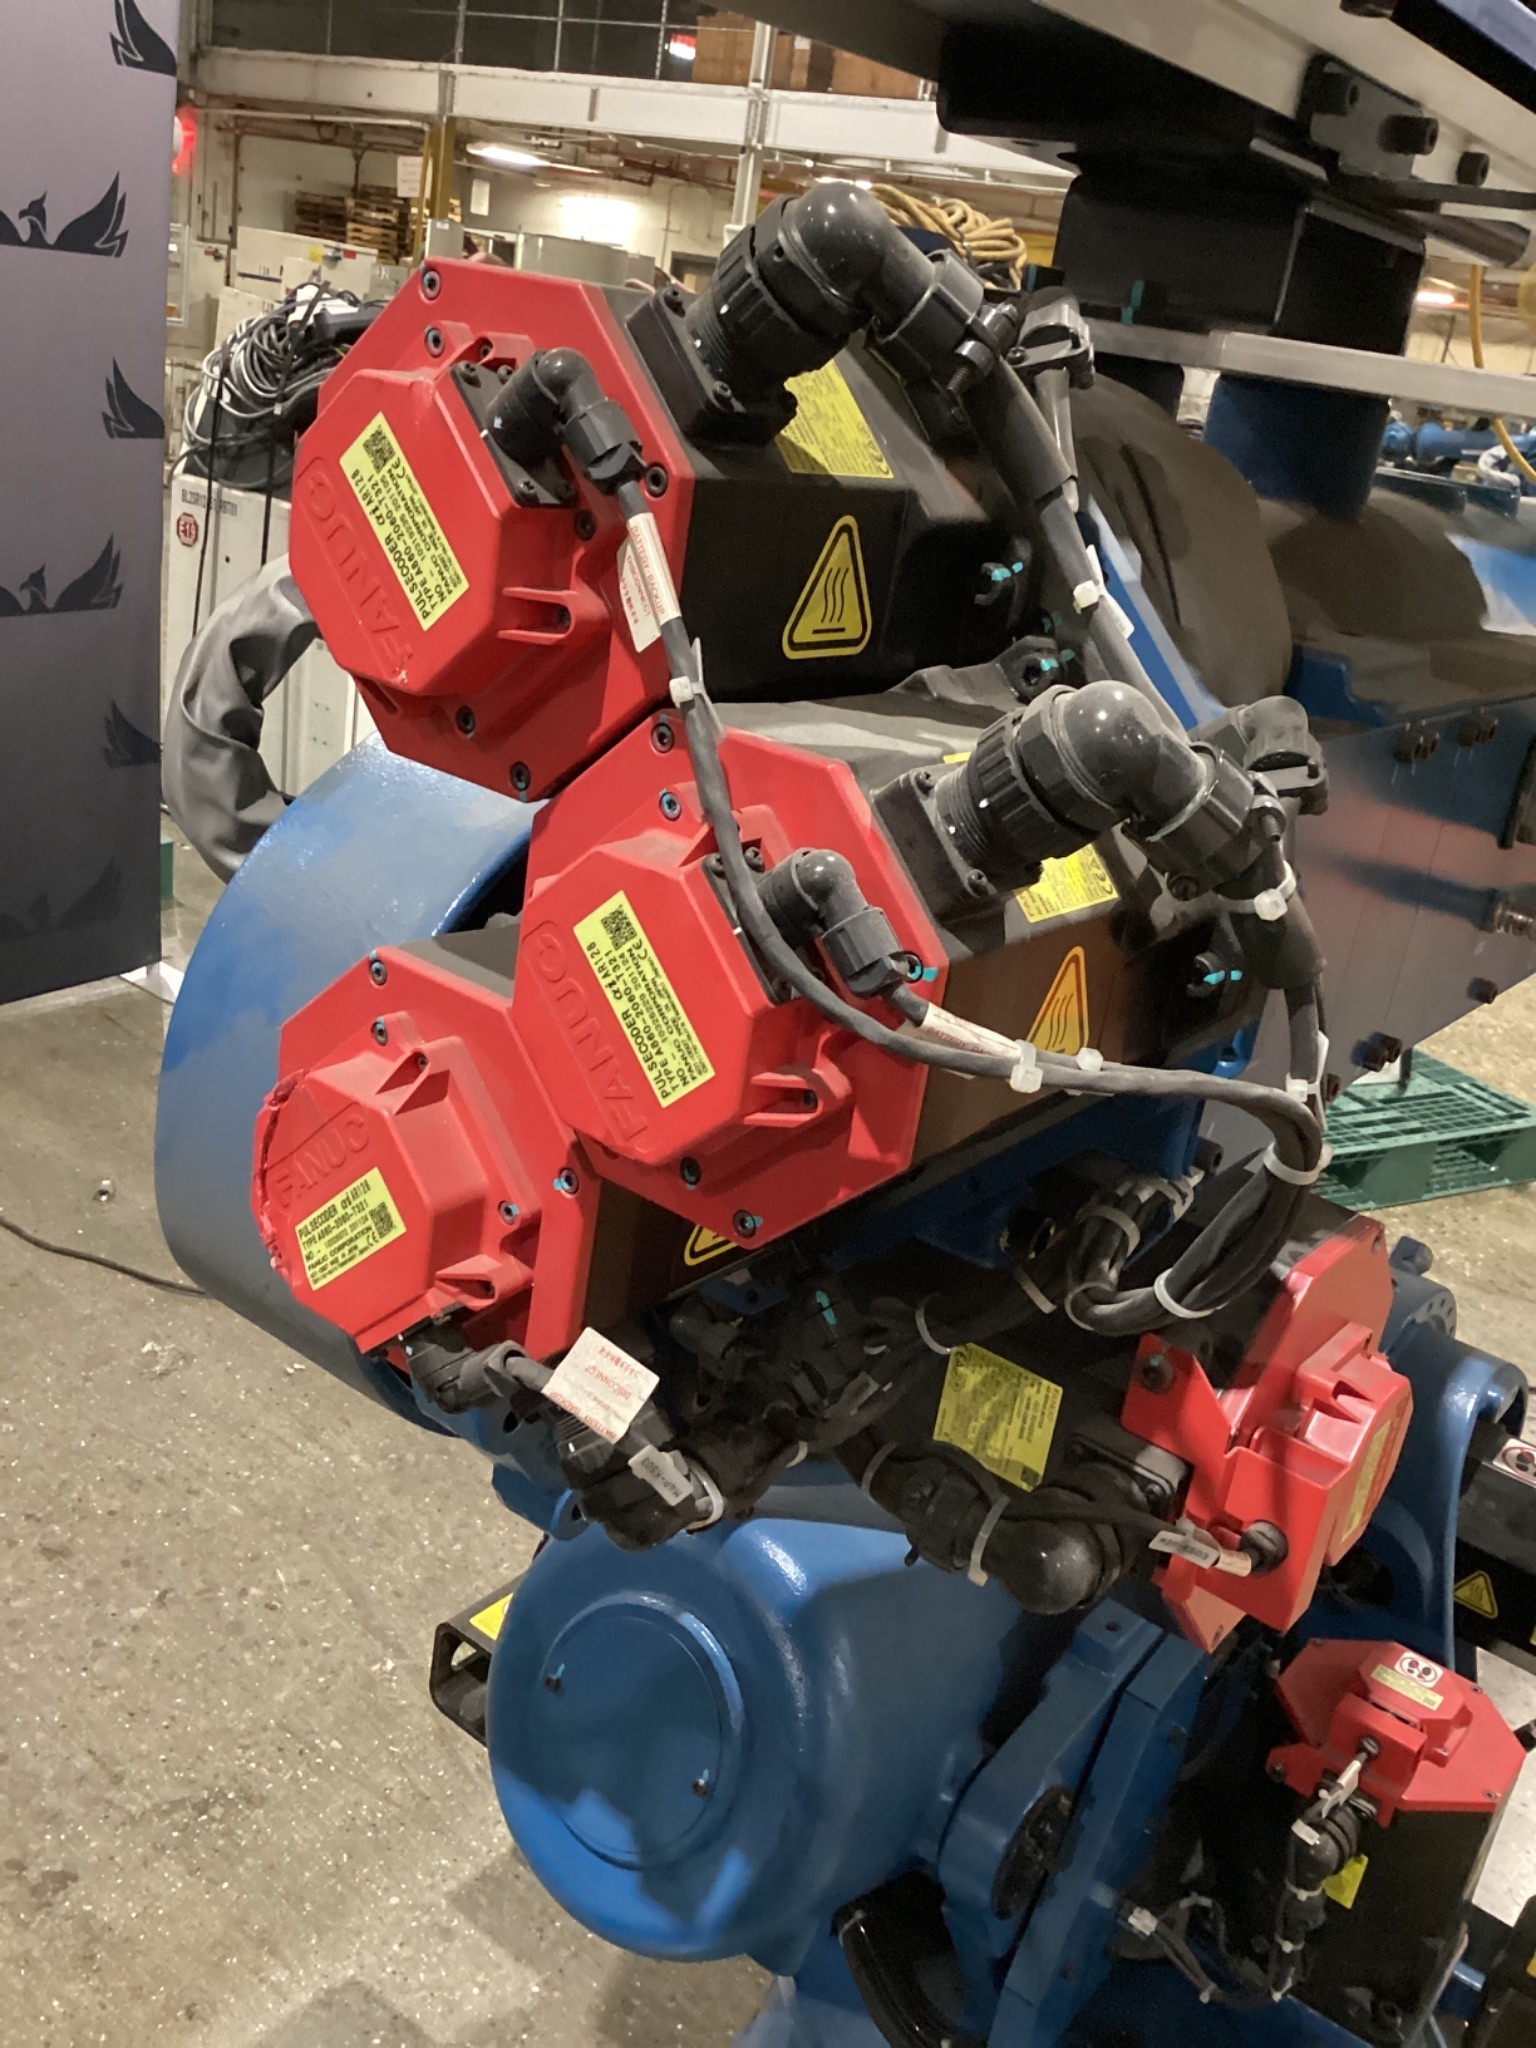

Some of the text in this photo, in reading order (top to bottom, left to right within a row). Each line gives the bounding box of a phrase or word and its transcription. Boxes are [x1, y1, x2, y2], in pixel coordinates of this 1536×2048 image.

[309, 471, 414, 677] FANUC
[367, 474, 438, 611] TYPE A860-2060-T321
[384, 532, 432, 620] PULSECODER
[387, 468, 453, 595] FANUC CORPORATION
[629, 525, 650, 569] BATTERY
[645, 573, 665, 615] BACKUP
[626, 555, 651, 617] DISCONNECT
[537, 933, 649, 1143] FANUC
[604, 949, 680, 1092] TYPE A860-2060-T321
[621, 1008, 672, 1100] PULSECODER
[626, 947, 698, 1081] FANUC CORPORATION
[928, 1027, 966, 1046] BATTERY
[275, 1114, 370, 1209] FANUC
[298, 1203, 339, 1240] PULSECODER
[301, 1234, 318, 1249] TYPE
[307, 1254, 328, 1271] FANUC
[329, 1225, 373, 1257] CORPORATION
[549, 1391, 617, 1439] BATTERY BACKUP
[584, 1363, 632, 1401] DISCONNECT
